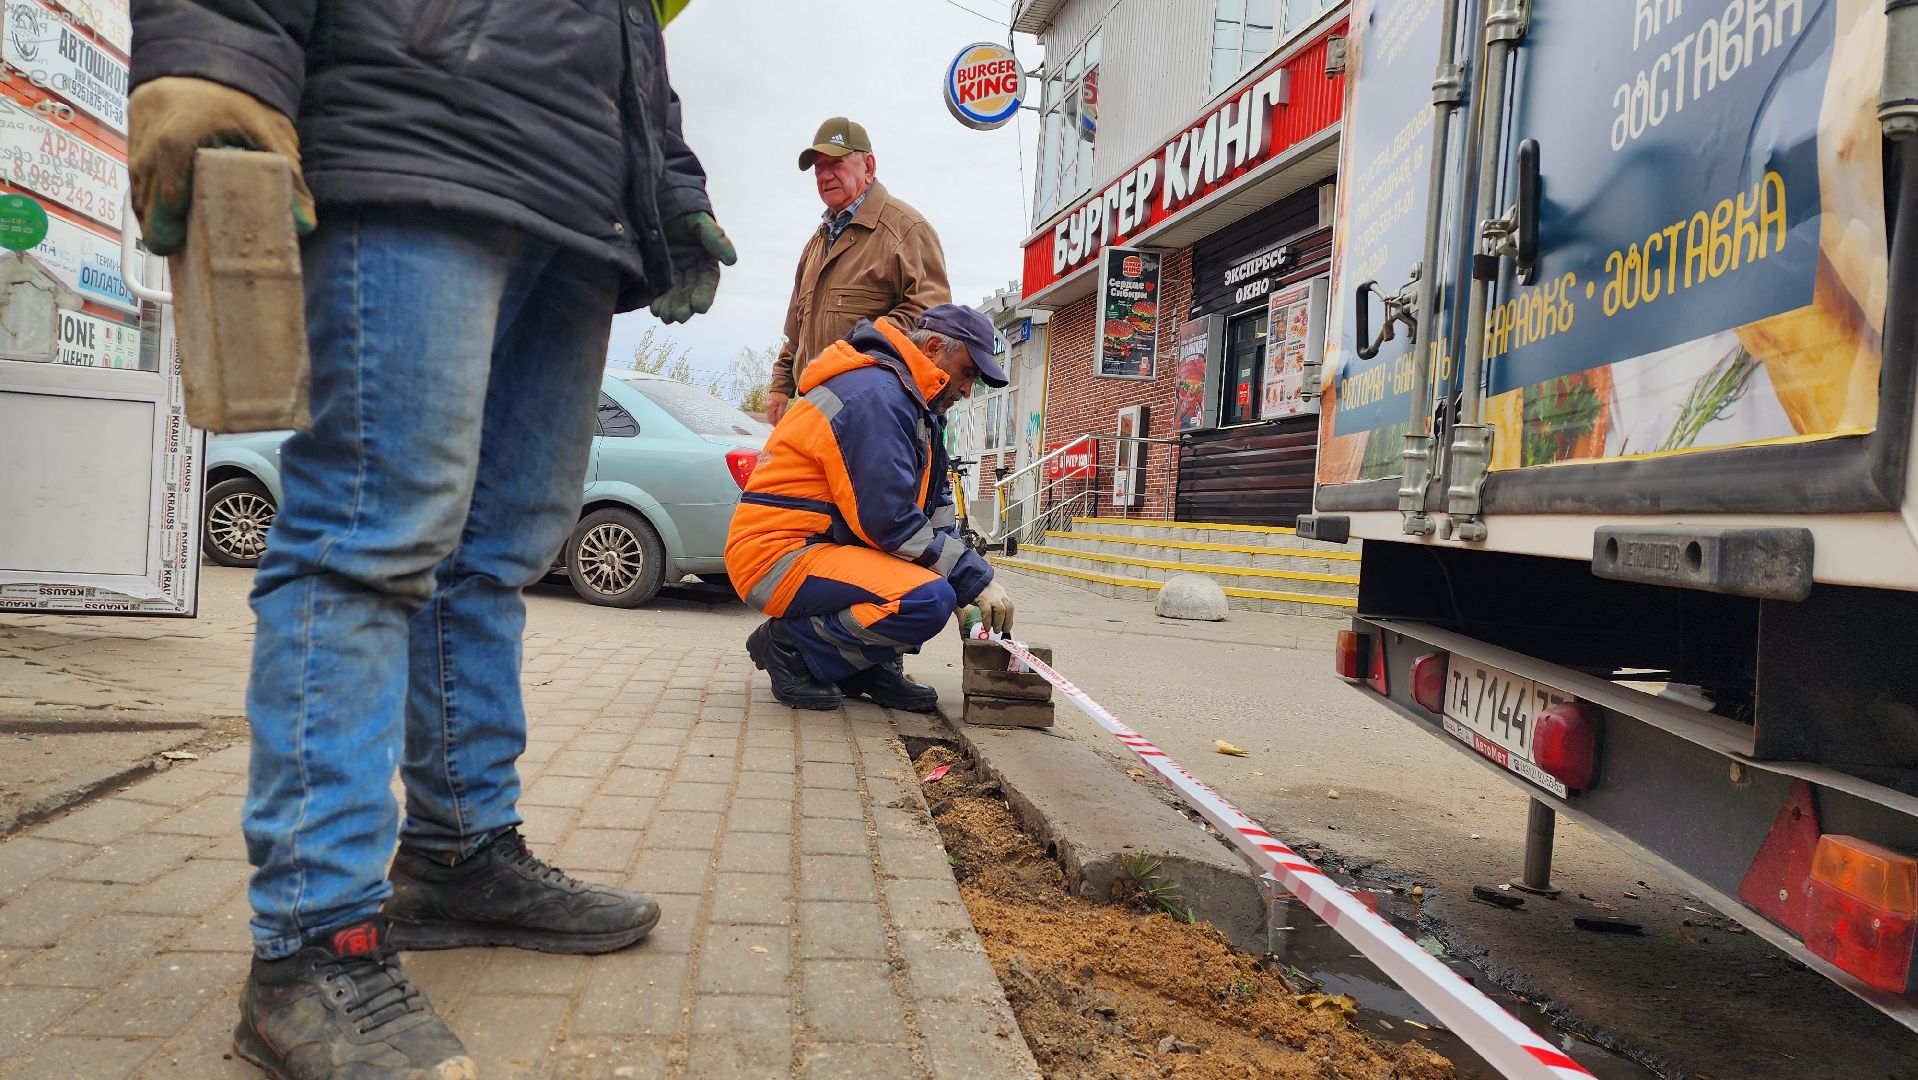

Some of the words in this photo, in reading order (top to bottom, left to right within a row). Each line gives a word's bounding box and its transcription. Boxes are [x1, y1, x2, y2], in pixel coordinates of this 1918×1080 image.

[958, 60, 1015, 84] BURGER
[960, 74, 1018, 104] KING
[40, 129, 118, 190] АРЕНДА
[1054, 158, 1157, 275] БУРГЕР
[1163, 68, 1283, 210] КИНГ
[66, 184, 94, 212] 242
[98, 197, 116, 221] 35
[1603, 171, 1786, 317] ДОСТАВКА
[1108, 278, 1145, 290] Сердце
[1224, 246, 1287, 286] ЭКСПРЕСС
[1110, 287, 1148, 300] Сибири
[1235, 277, 1270, 304] ОКНО
[1341, 363, 1386, 412] РЕСТОРАН
[170, 415, 180, 454] KRAUSS
[167, 492, 176, 530] KRAUSS
[39, 587, 85, 597] KRAUSS
[1452, 670, 1469, 718] ТА
[1475, 668, 1528, 749] 7144
